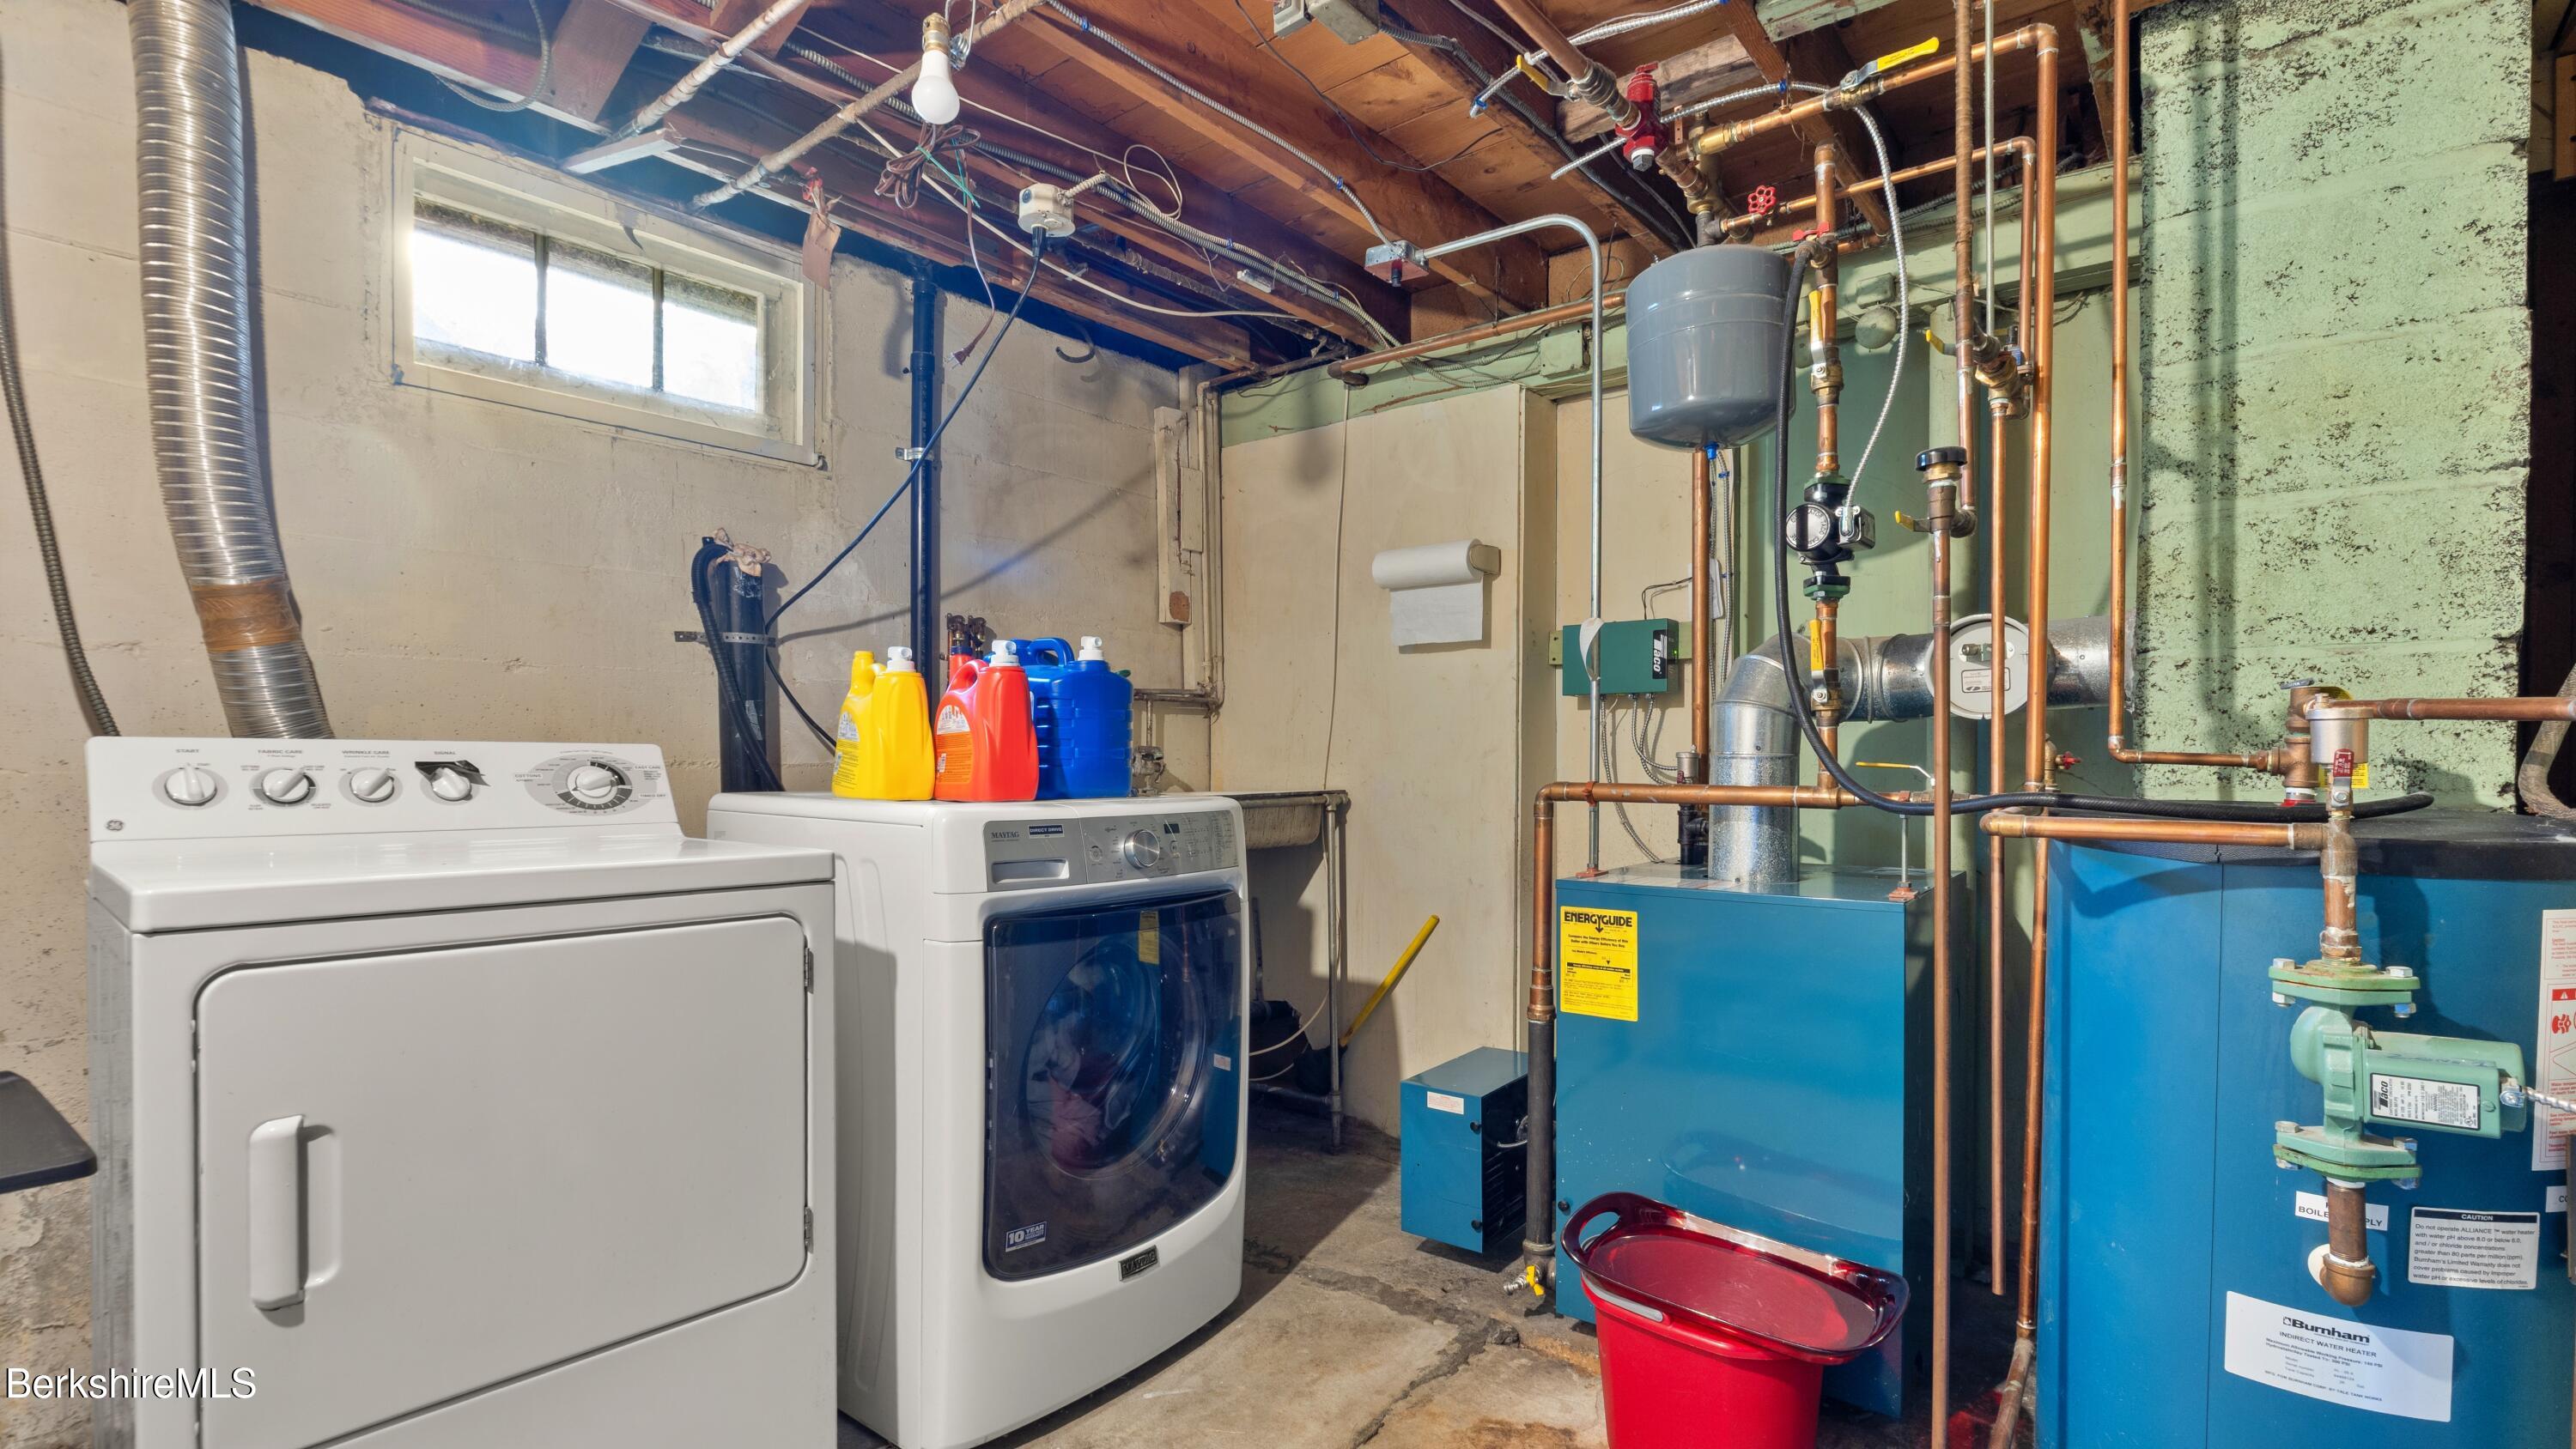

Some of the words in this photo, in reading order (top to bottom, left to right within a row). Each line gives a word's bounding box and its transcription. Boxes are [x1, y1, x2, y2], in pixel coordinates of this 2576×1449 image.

[1564, 911, 1633, 928] ENERGYGUIDE
[2299, 1205, 2329, 1217] BOILE
[1008, 1230, 1025, 1245] 10
[1025, 1224, 1045, 1234] YEAR
[1121, 1251, 1157, 1276] MAYTAG
[2291, 1319, 2370, 1344] Burnham
[2279, 1331, 2315, 1344] INDIRECT
[2316, 1340, 2344, 1352] WATER
[2345, 1347, 2377, 1358] HEATER
